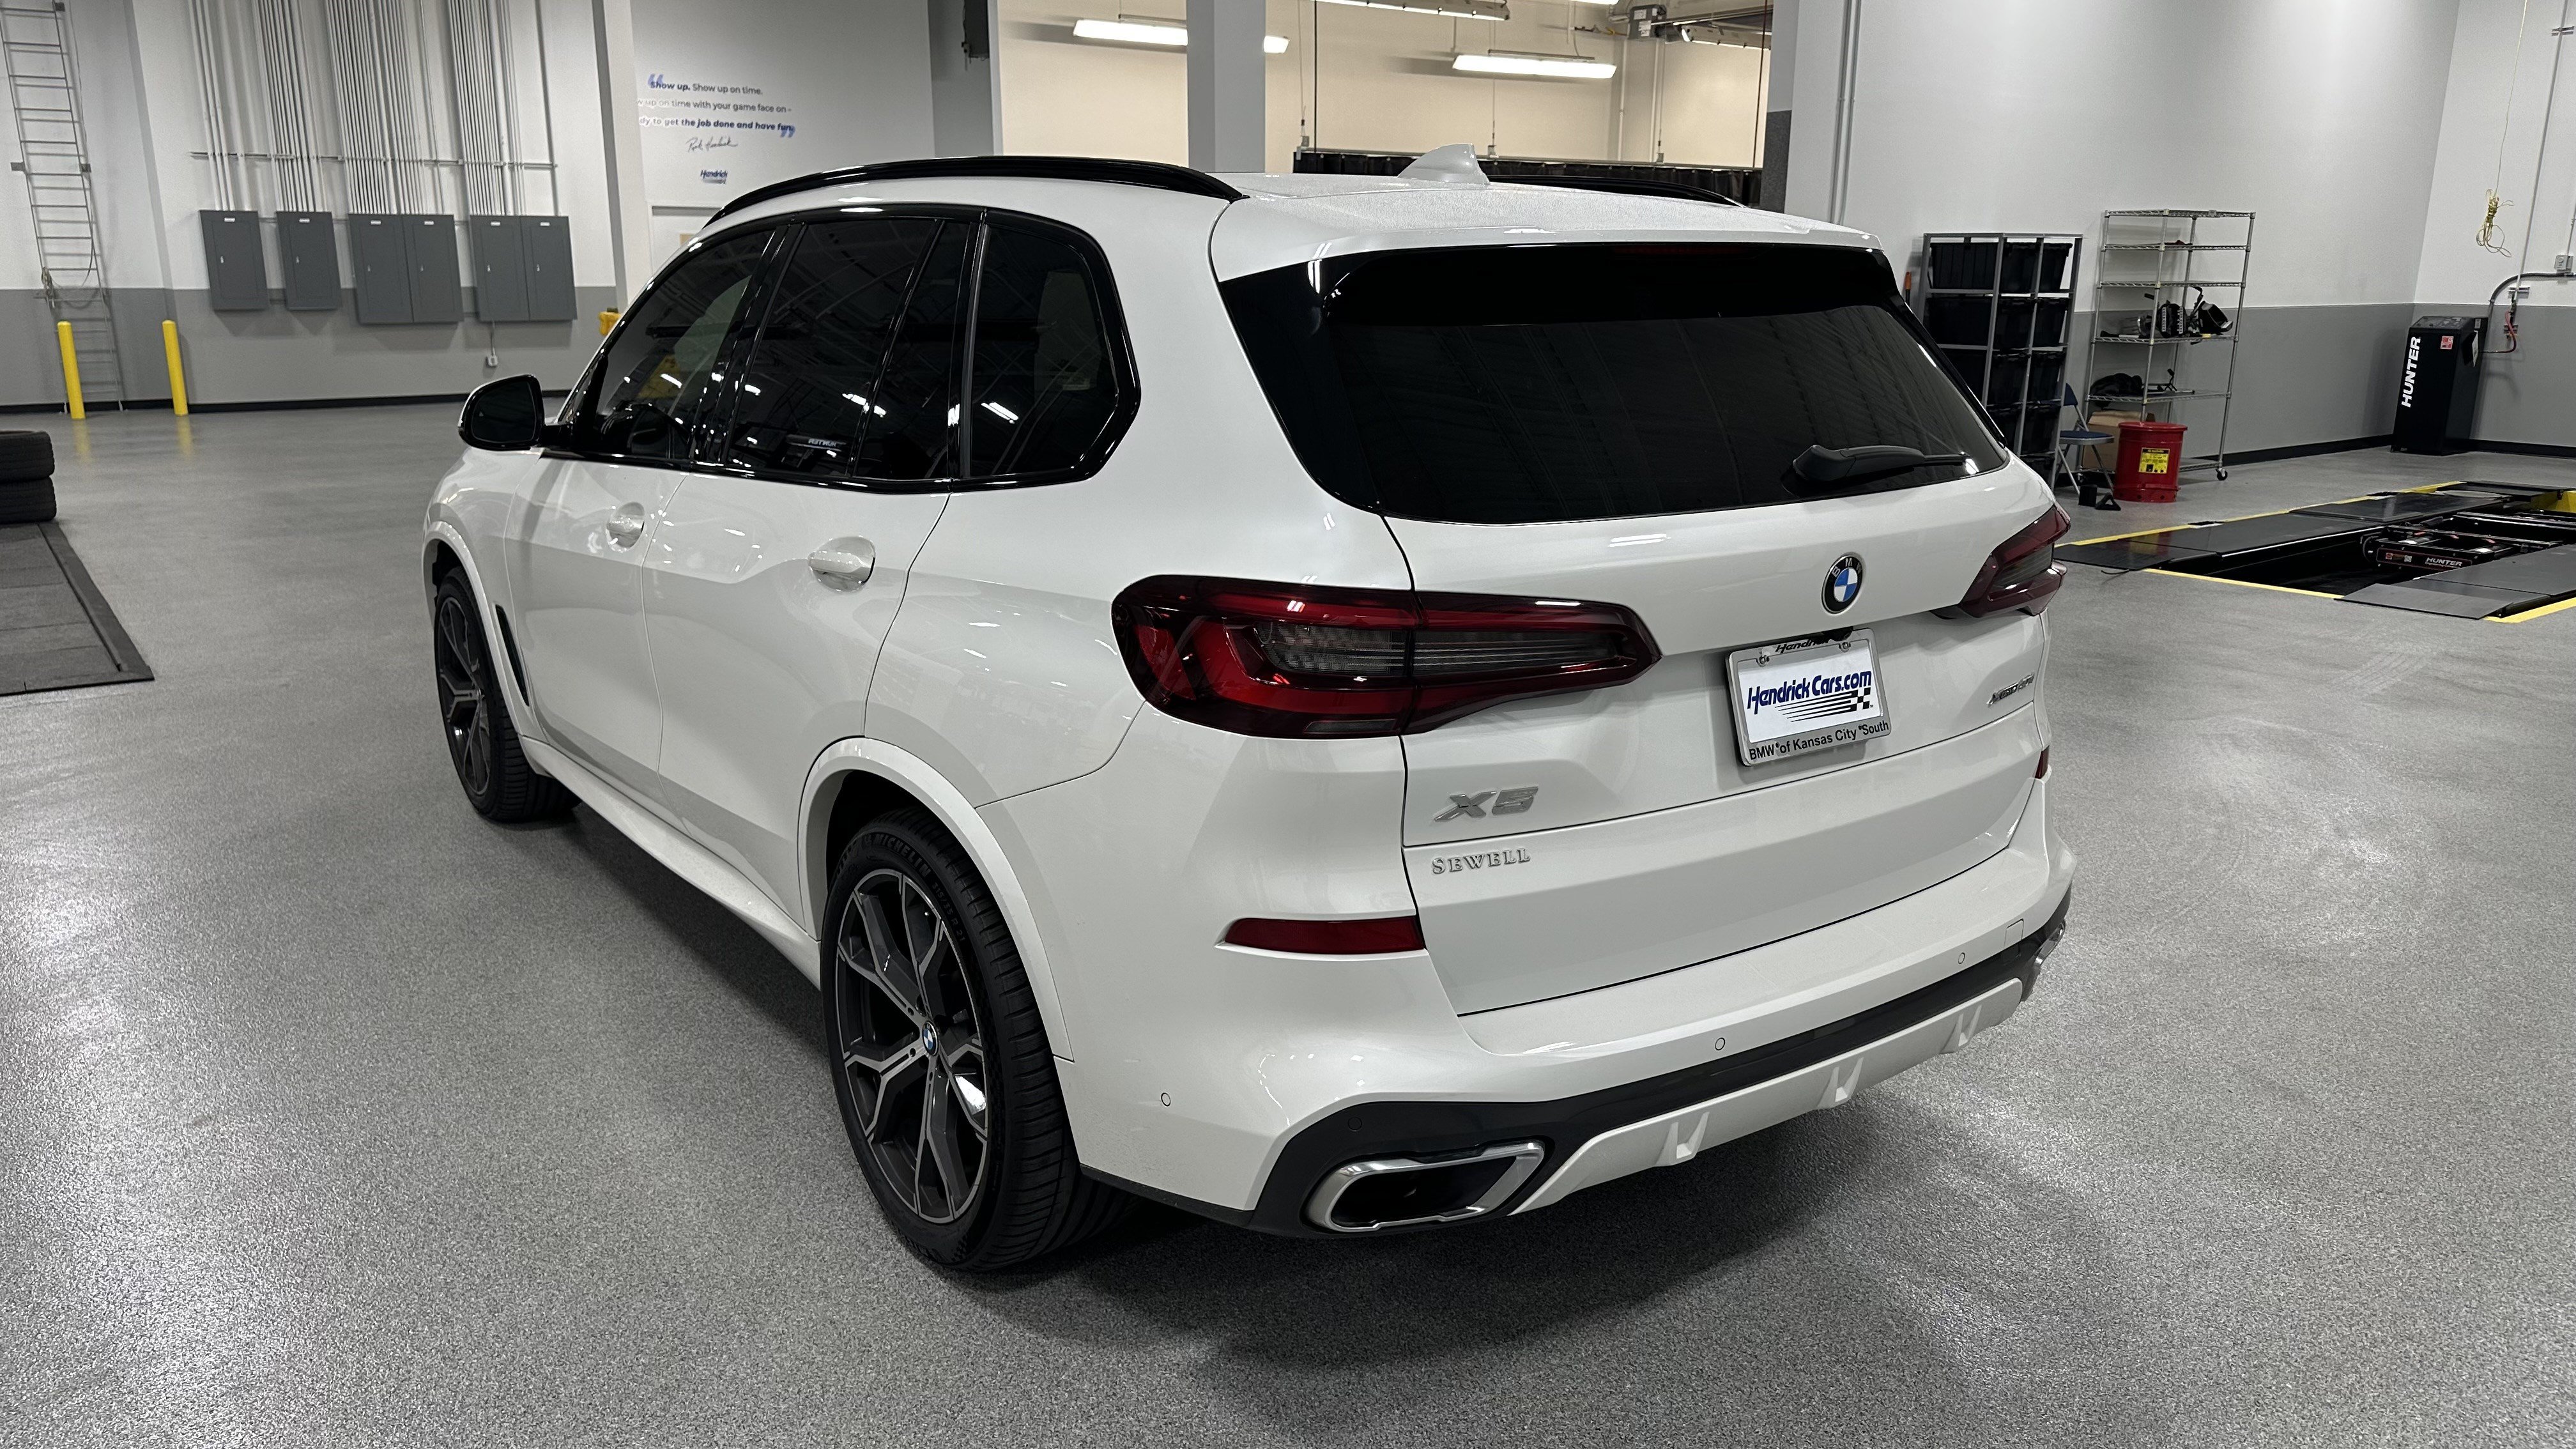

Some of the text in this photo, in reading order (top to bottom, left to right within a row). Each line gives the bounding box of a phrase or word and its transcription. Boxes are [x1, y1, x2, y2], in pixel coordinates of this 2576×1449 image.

[693, 83, 716, 92] Show
[717, 86, 728, 94] up
[742, 86, 763, 95] time.
[671, 99, 691, 108] time
[693, 100, 711, 109] with
[713, 102, 731, 111] your
[733, 103, 756, 112] game
[757, 103, 774, 112] face
[681, 118, 696, 126] the
[696, 118, 712, 128] job
[713, 119, 735, 128] done
[755, 121, 776, 130] have
[2401, 336, 2421, 408] HUNTER
[1831, 557, 1862, 578] BMW
[2426, 557, 2463, 567] HUNTER
[1775, 638, 1829, 654] Hendr
[1749, 719, 1889, 760] BMW of Kansas City South
[1434, 786, 1539, 822] X5
[875, 832, 931, 878] MICHELIN
[1431, 847, 1531, 875] SEWELL
